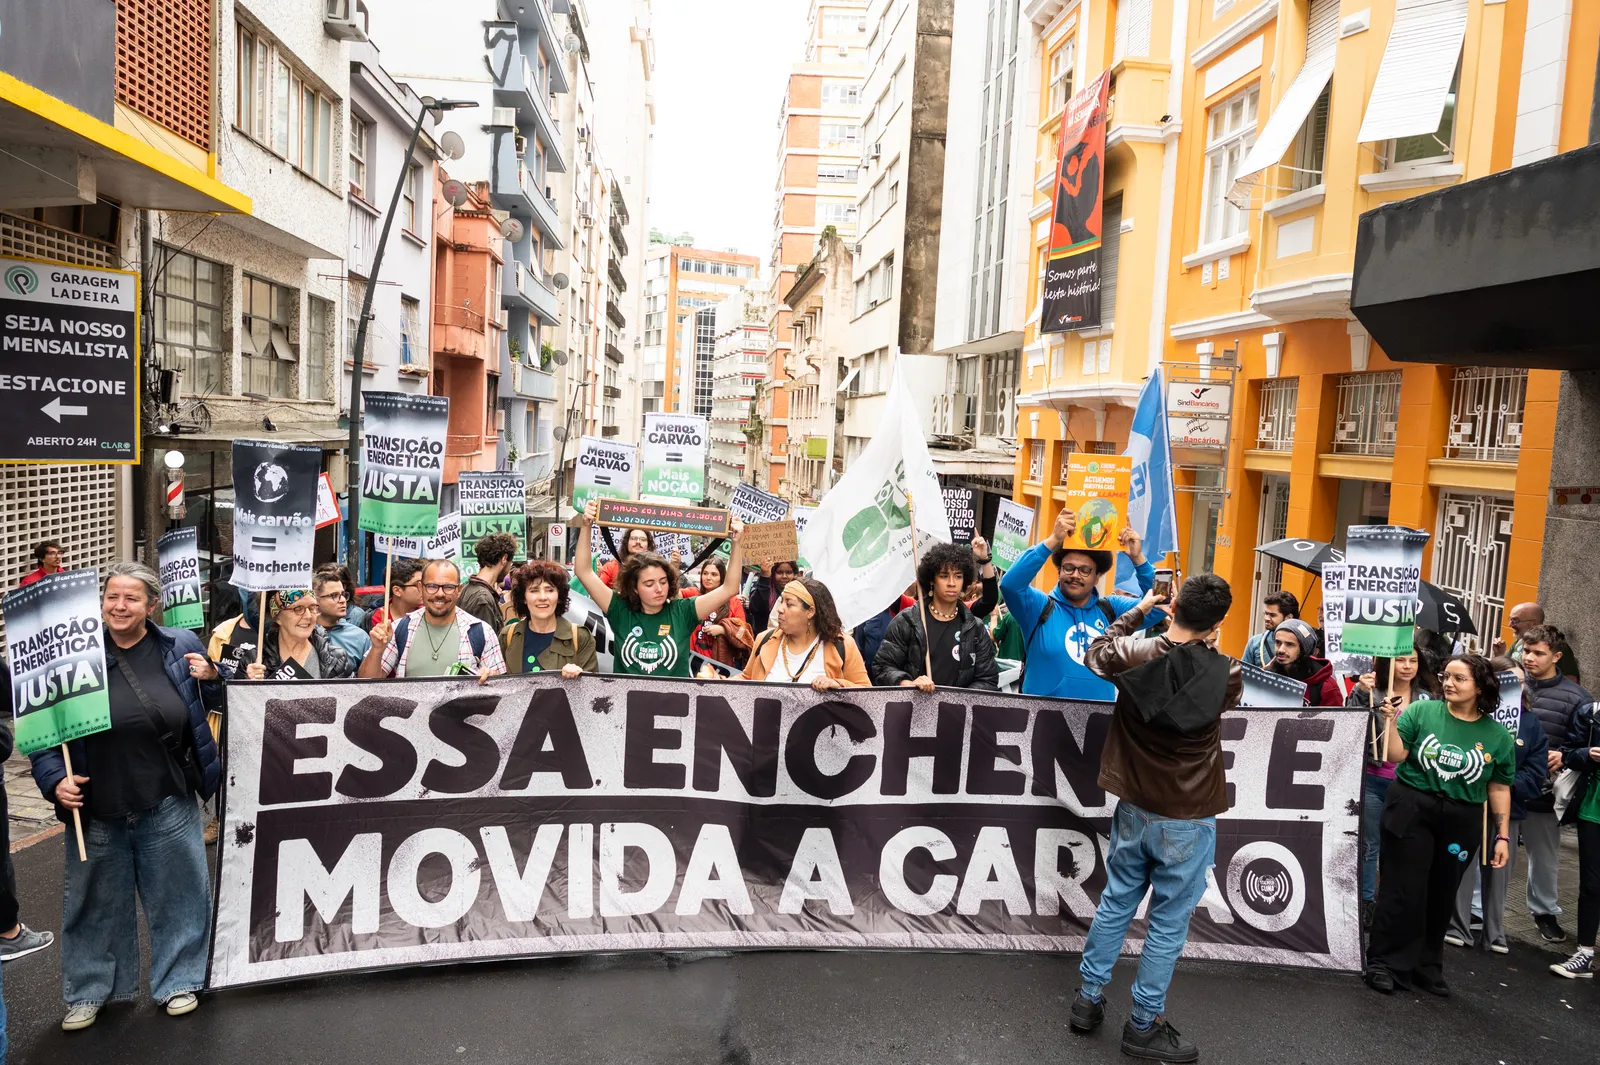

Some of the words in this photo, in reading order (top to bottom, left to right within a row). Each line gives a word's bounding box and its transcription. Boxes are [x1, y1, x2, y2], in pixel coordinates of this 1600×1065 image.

[51, 272, 119, 290] GARAGEM
[1048, 269, 1076, 283] Somos
[1077, 261, 1097, 280] parte
[52, 288, 120, 304] LADEIRA
[1068, 278, 1100, 298] história!
[5, 314, 54, 332] SEJA
[60, 320, 126, 338] NOSSO
[3, 336, 128, 360] MENSALISTA
[0, 375, 126, 395] ESTACIONE
[656, 423, 696, 434] Menos
[27, 437, 74, 446] ABERTO
[78, 438, 96, 446] 24H
[365, 436, 443, 457] TRANSIÇÃO
[367, 450, 440, 469] ENERGÉTICA
[587, 445, 626, 460] Menos
[659, 468, 690, 480] Mais
[365, 470, 434, 501] JUSTA
[941, 488, 972, 500] ARVÃO
[462, 502, 522, 514] INCLUSIVA
[944, 498, 968, 509] OSSO
[236, 507, 256, 524] Mais
[258, 512, 312, 526] carvão
[946, 508, 974, 519] UTURO
[464, 520, 522, 538] JUSTA
[1217, 534, 1231, 548] 424
[248, 560, 310, 573] enchente
[1348, 564, 1419, 580] TRANSIÇÃO
[54, 571, 94, 582] #carvãonão
[1349, 598, 1414, 623] JUSTA
[10, 615, 99, 660] TRANSIÇÃO
[14, 634, 100, 676] ENERGÉTICA
[18, 660, 100, 713] JUSTA
[258, 688, 594, 806] ESSA
[622, 690, 1250, 810] ENCHEN
[1438, 756, 1462, 768] CLIMA
[275, 823, 754, 943] MOVIDA
[778, 827, 854, 916] A
[879, 826, 1306, 932] CARO
